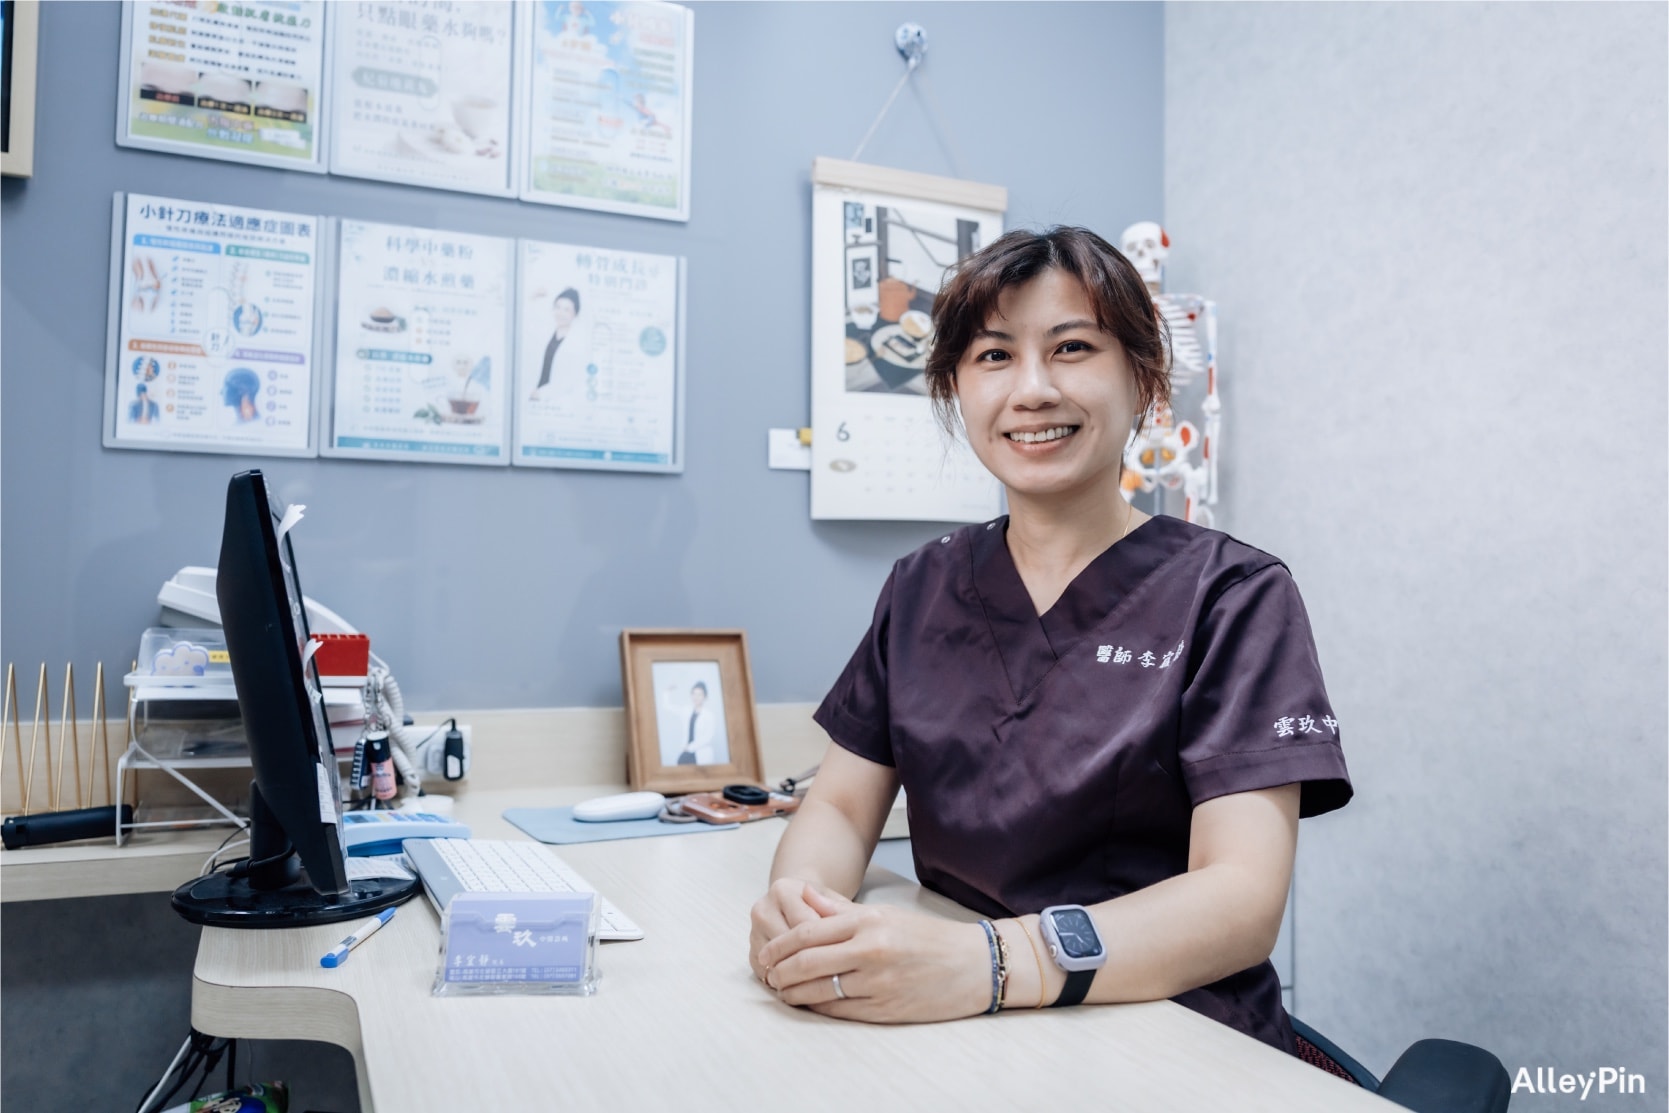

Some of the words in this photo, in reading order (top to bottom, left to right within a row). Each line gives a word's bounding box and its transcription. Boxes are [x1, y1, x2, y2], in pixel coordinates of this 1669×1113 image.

[139, 203, 312, 238] 小針刀療法適應症圖表
[836, 420, 851, 442] 6
[1096, 645, 1132, 665] 醫師
[1273, 714, 1339, 738] 雲玖中
